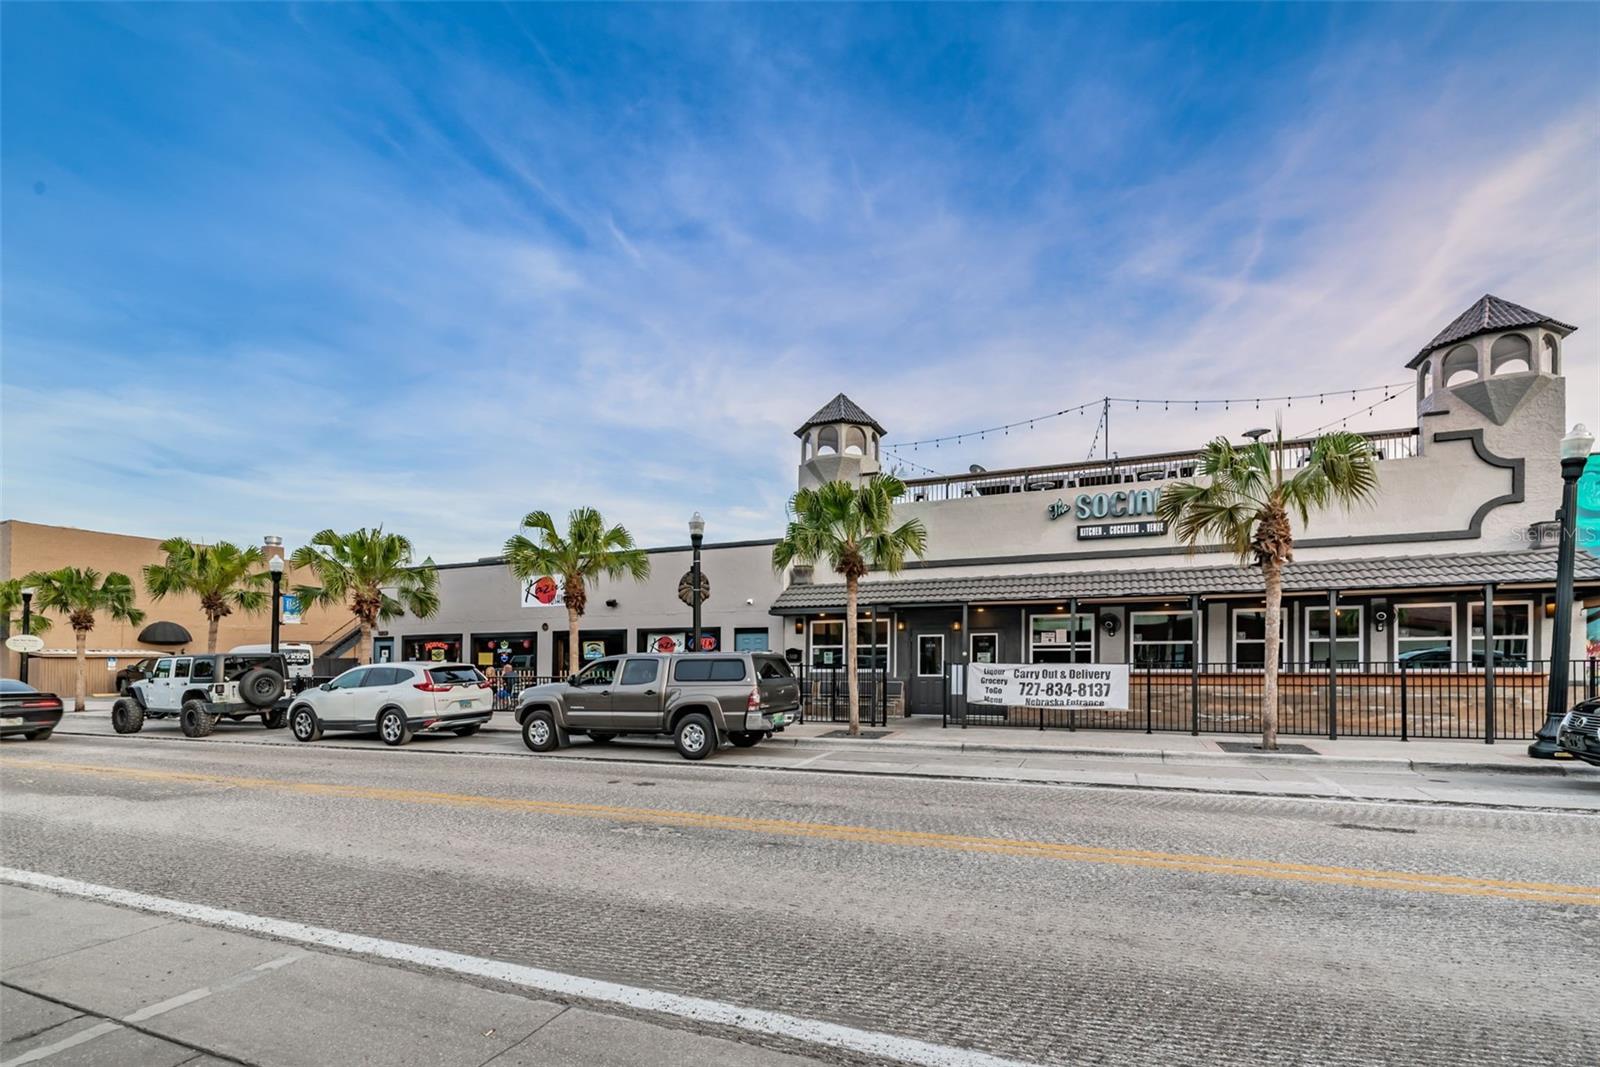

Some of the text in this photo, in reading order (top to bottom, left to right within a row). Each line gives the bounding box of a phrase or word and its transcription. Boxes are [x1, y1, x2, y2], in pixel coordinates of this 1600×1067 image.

[1048, 498, 1071, 520] The
[1013, 669, 1111, 680] Carry Out & Delivery
[981, 677, 1008, 685] Grocery
[1019, 682, 1111, 697] 727-834-8137
[1025, 698, 1105, 707] Nebraska Entrance
